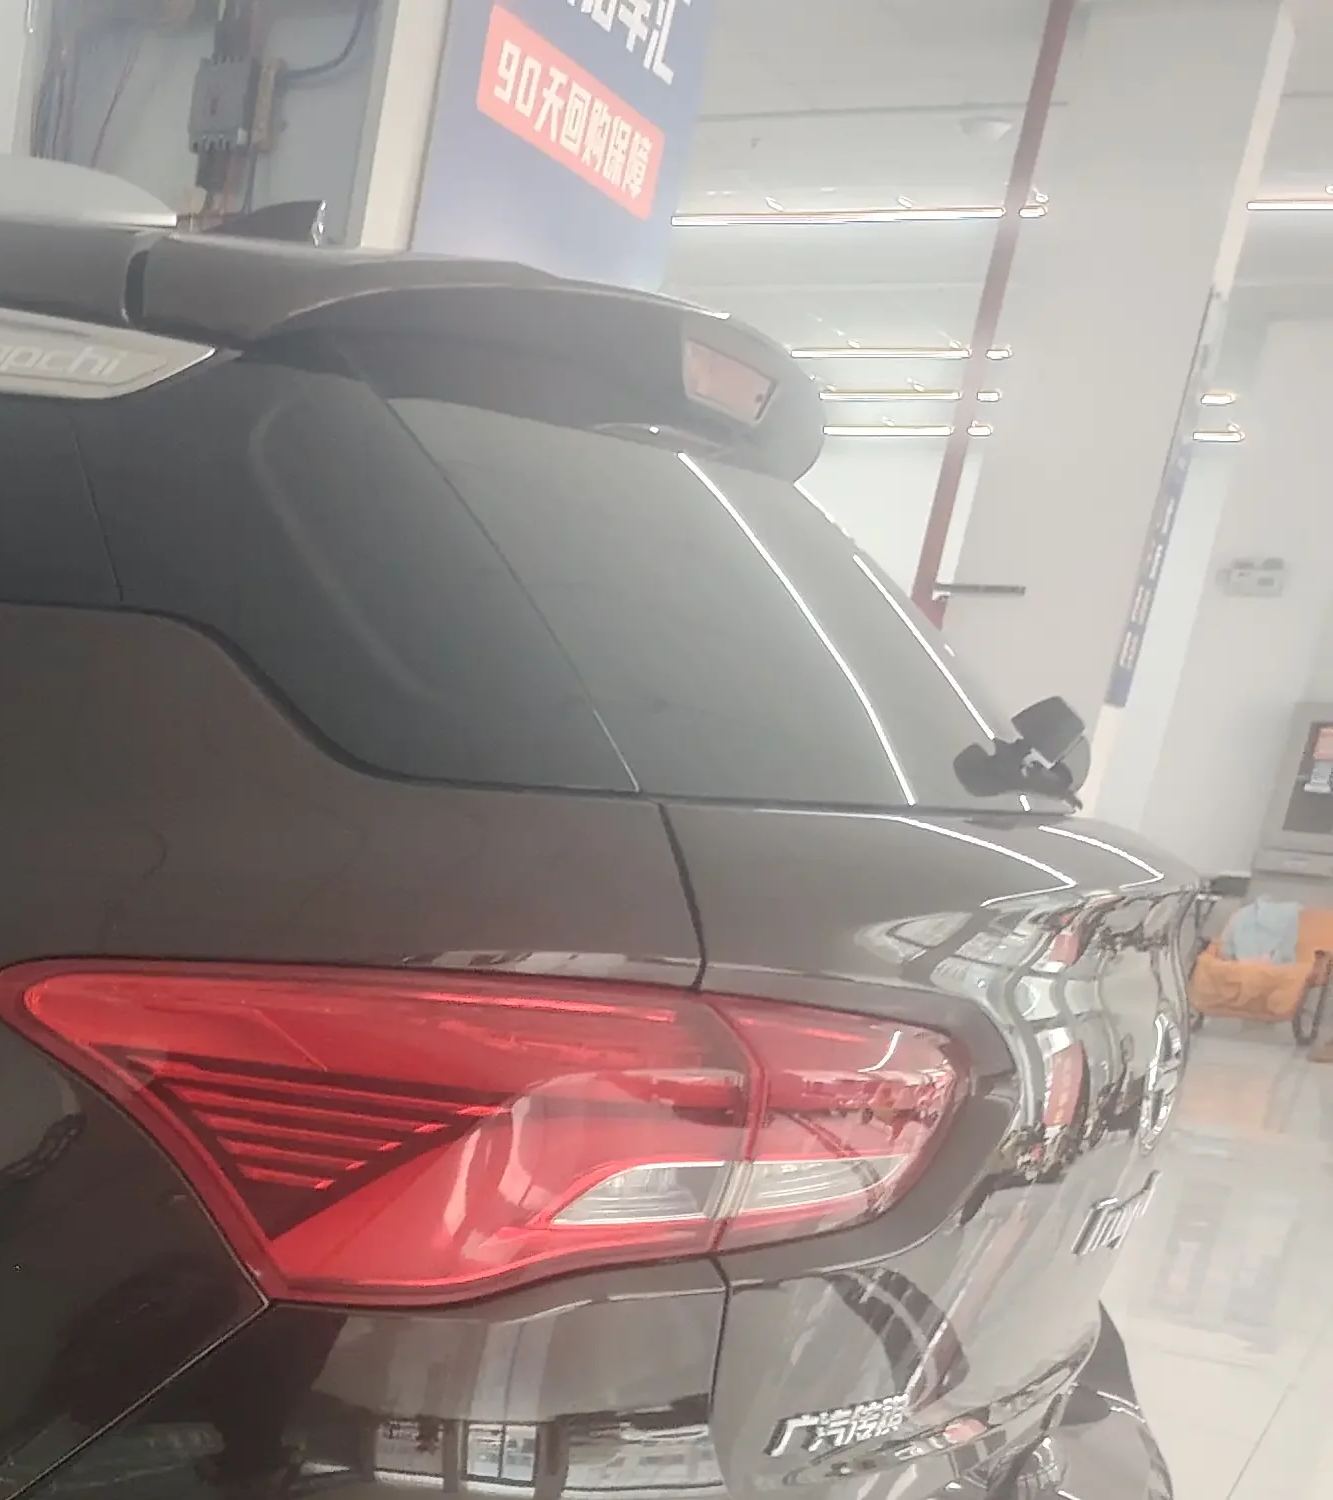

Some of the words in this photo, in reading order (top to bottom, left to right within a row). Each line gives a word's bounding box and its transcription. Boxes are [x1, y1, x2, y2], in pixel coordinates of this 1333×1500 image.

[493, 39, 654, 200] 90天回购保障
